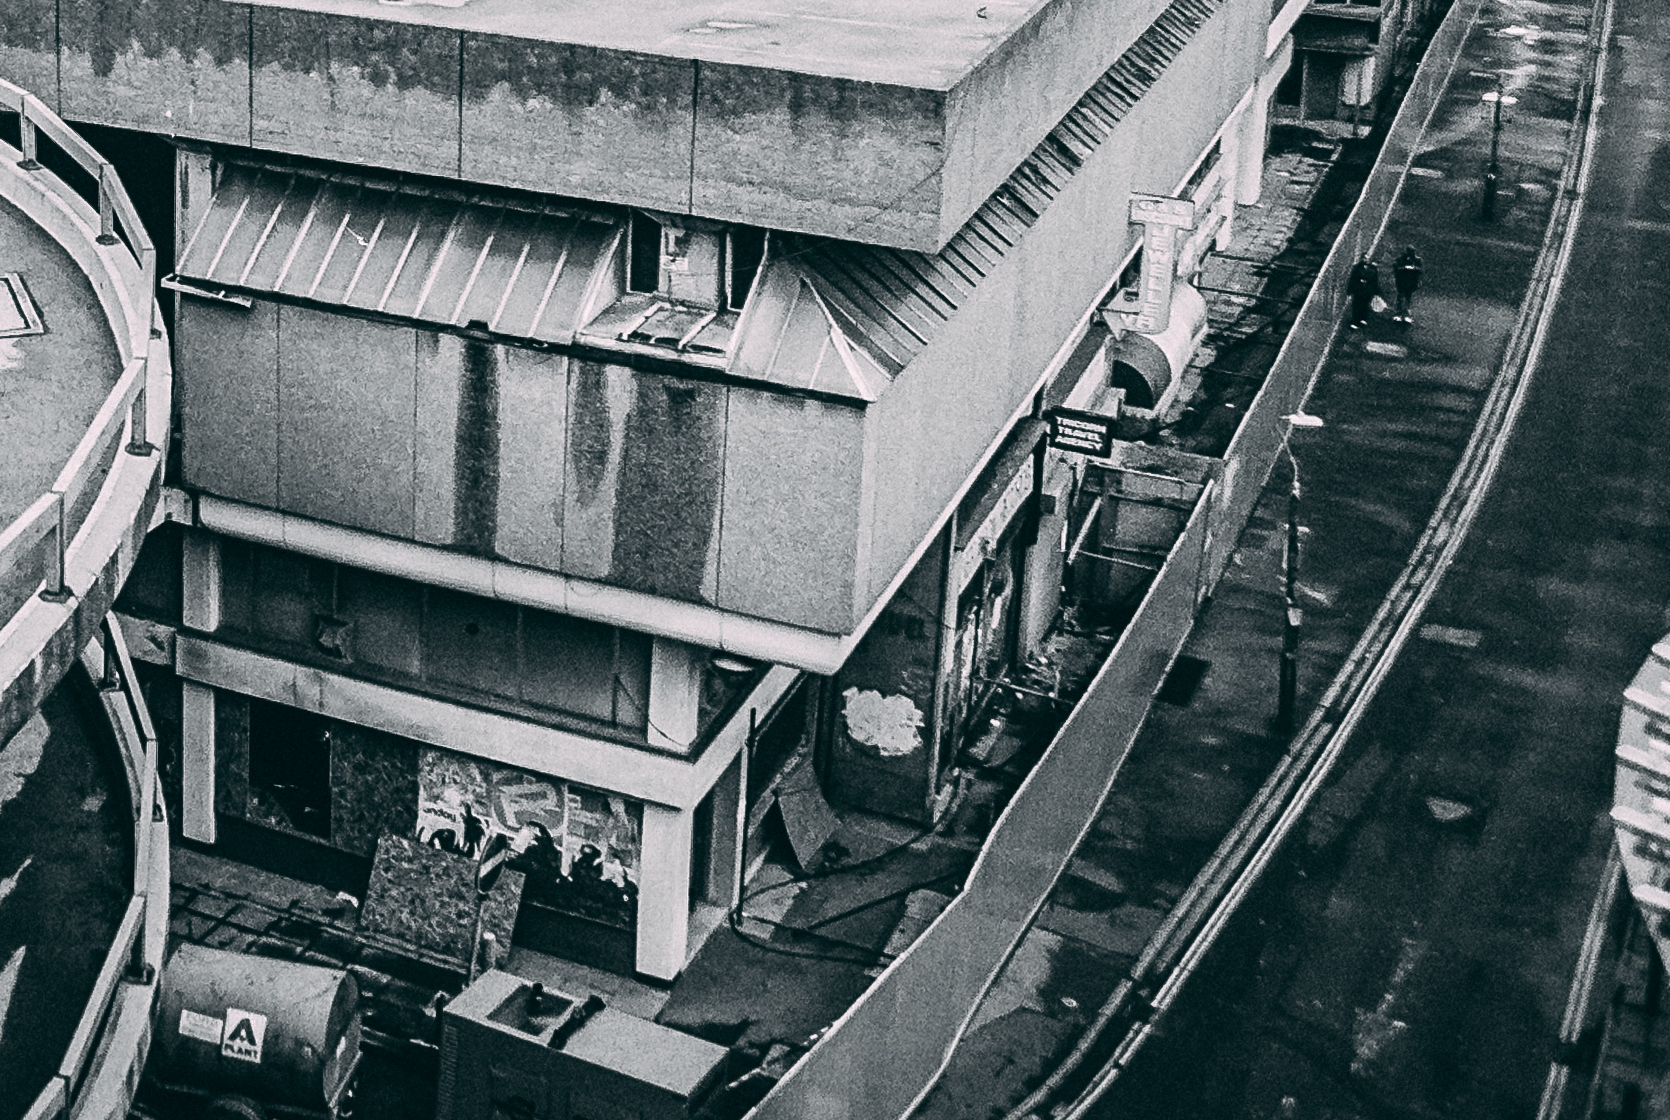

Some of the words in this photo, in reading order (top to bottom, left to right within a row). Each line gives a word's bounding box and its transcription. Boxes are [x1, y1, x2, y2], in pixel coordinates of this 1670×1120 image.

[1055, 416, 1107, 433] TRICORN
[1058, 426, 1102, 442] TRAVEL
[227, 1018, 257, 1046] A
[224, 1043, 258, 1060] PLANT
